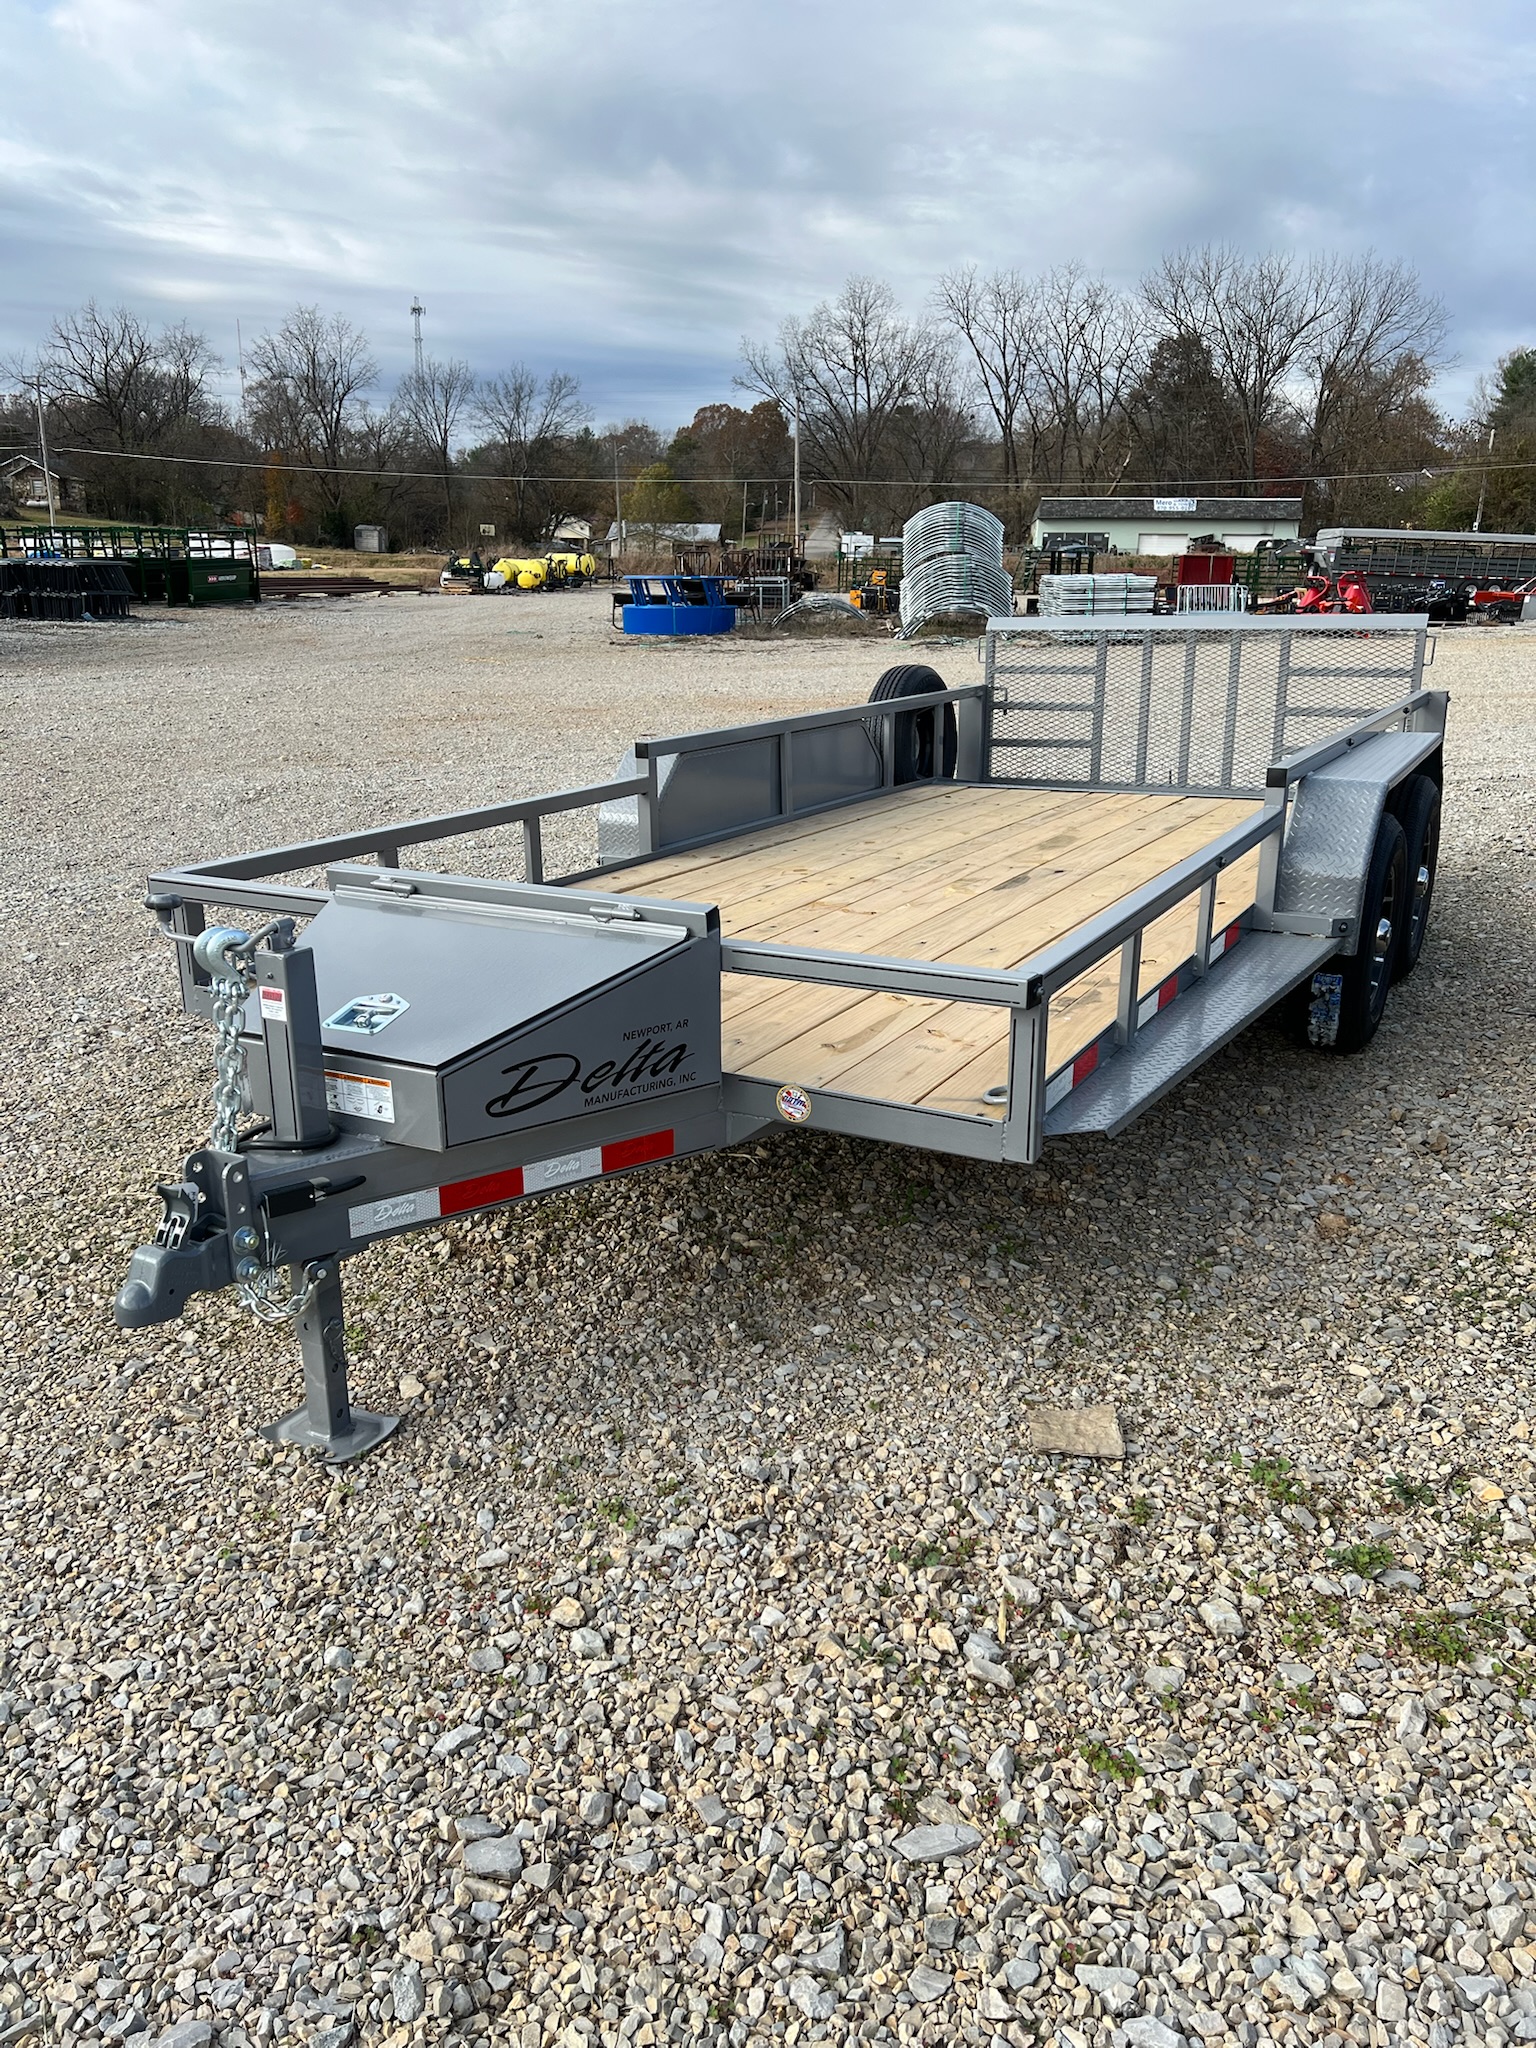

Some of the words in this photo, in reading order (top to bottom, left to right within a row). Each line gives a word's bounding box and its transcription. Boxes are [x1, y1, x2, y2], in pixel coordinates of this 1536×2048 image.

[622, 1022, 673, 1041] NEWPORT,
[675, 1018, 689, 1029] AR
[485, 1038, 695, 1118] Delta
[584, 1078, 676, 1108] MANUFACTURING,
[679, 1071, 697, 1083] INC
[544, 1159, 580, 1178] Delta
[373, 1202, 416, 1222] Delta
